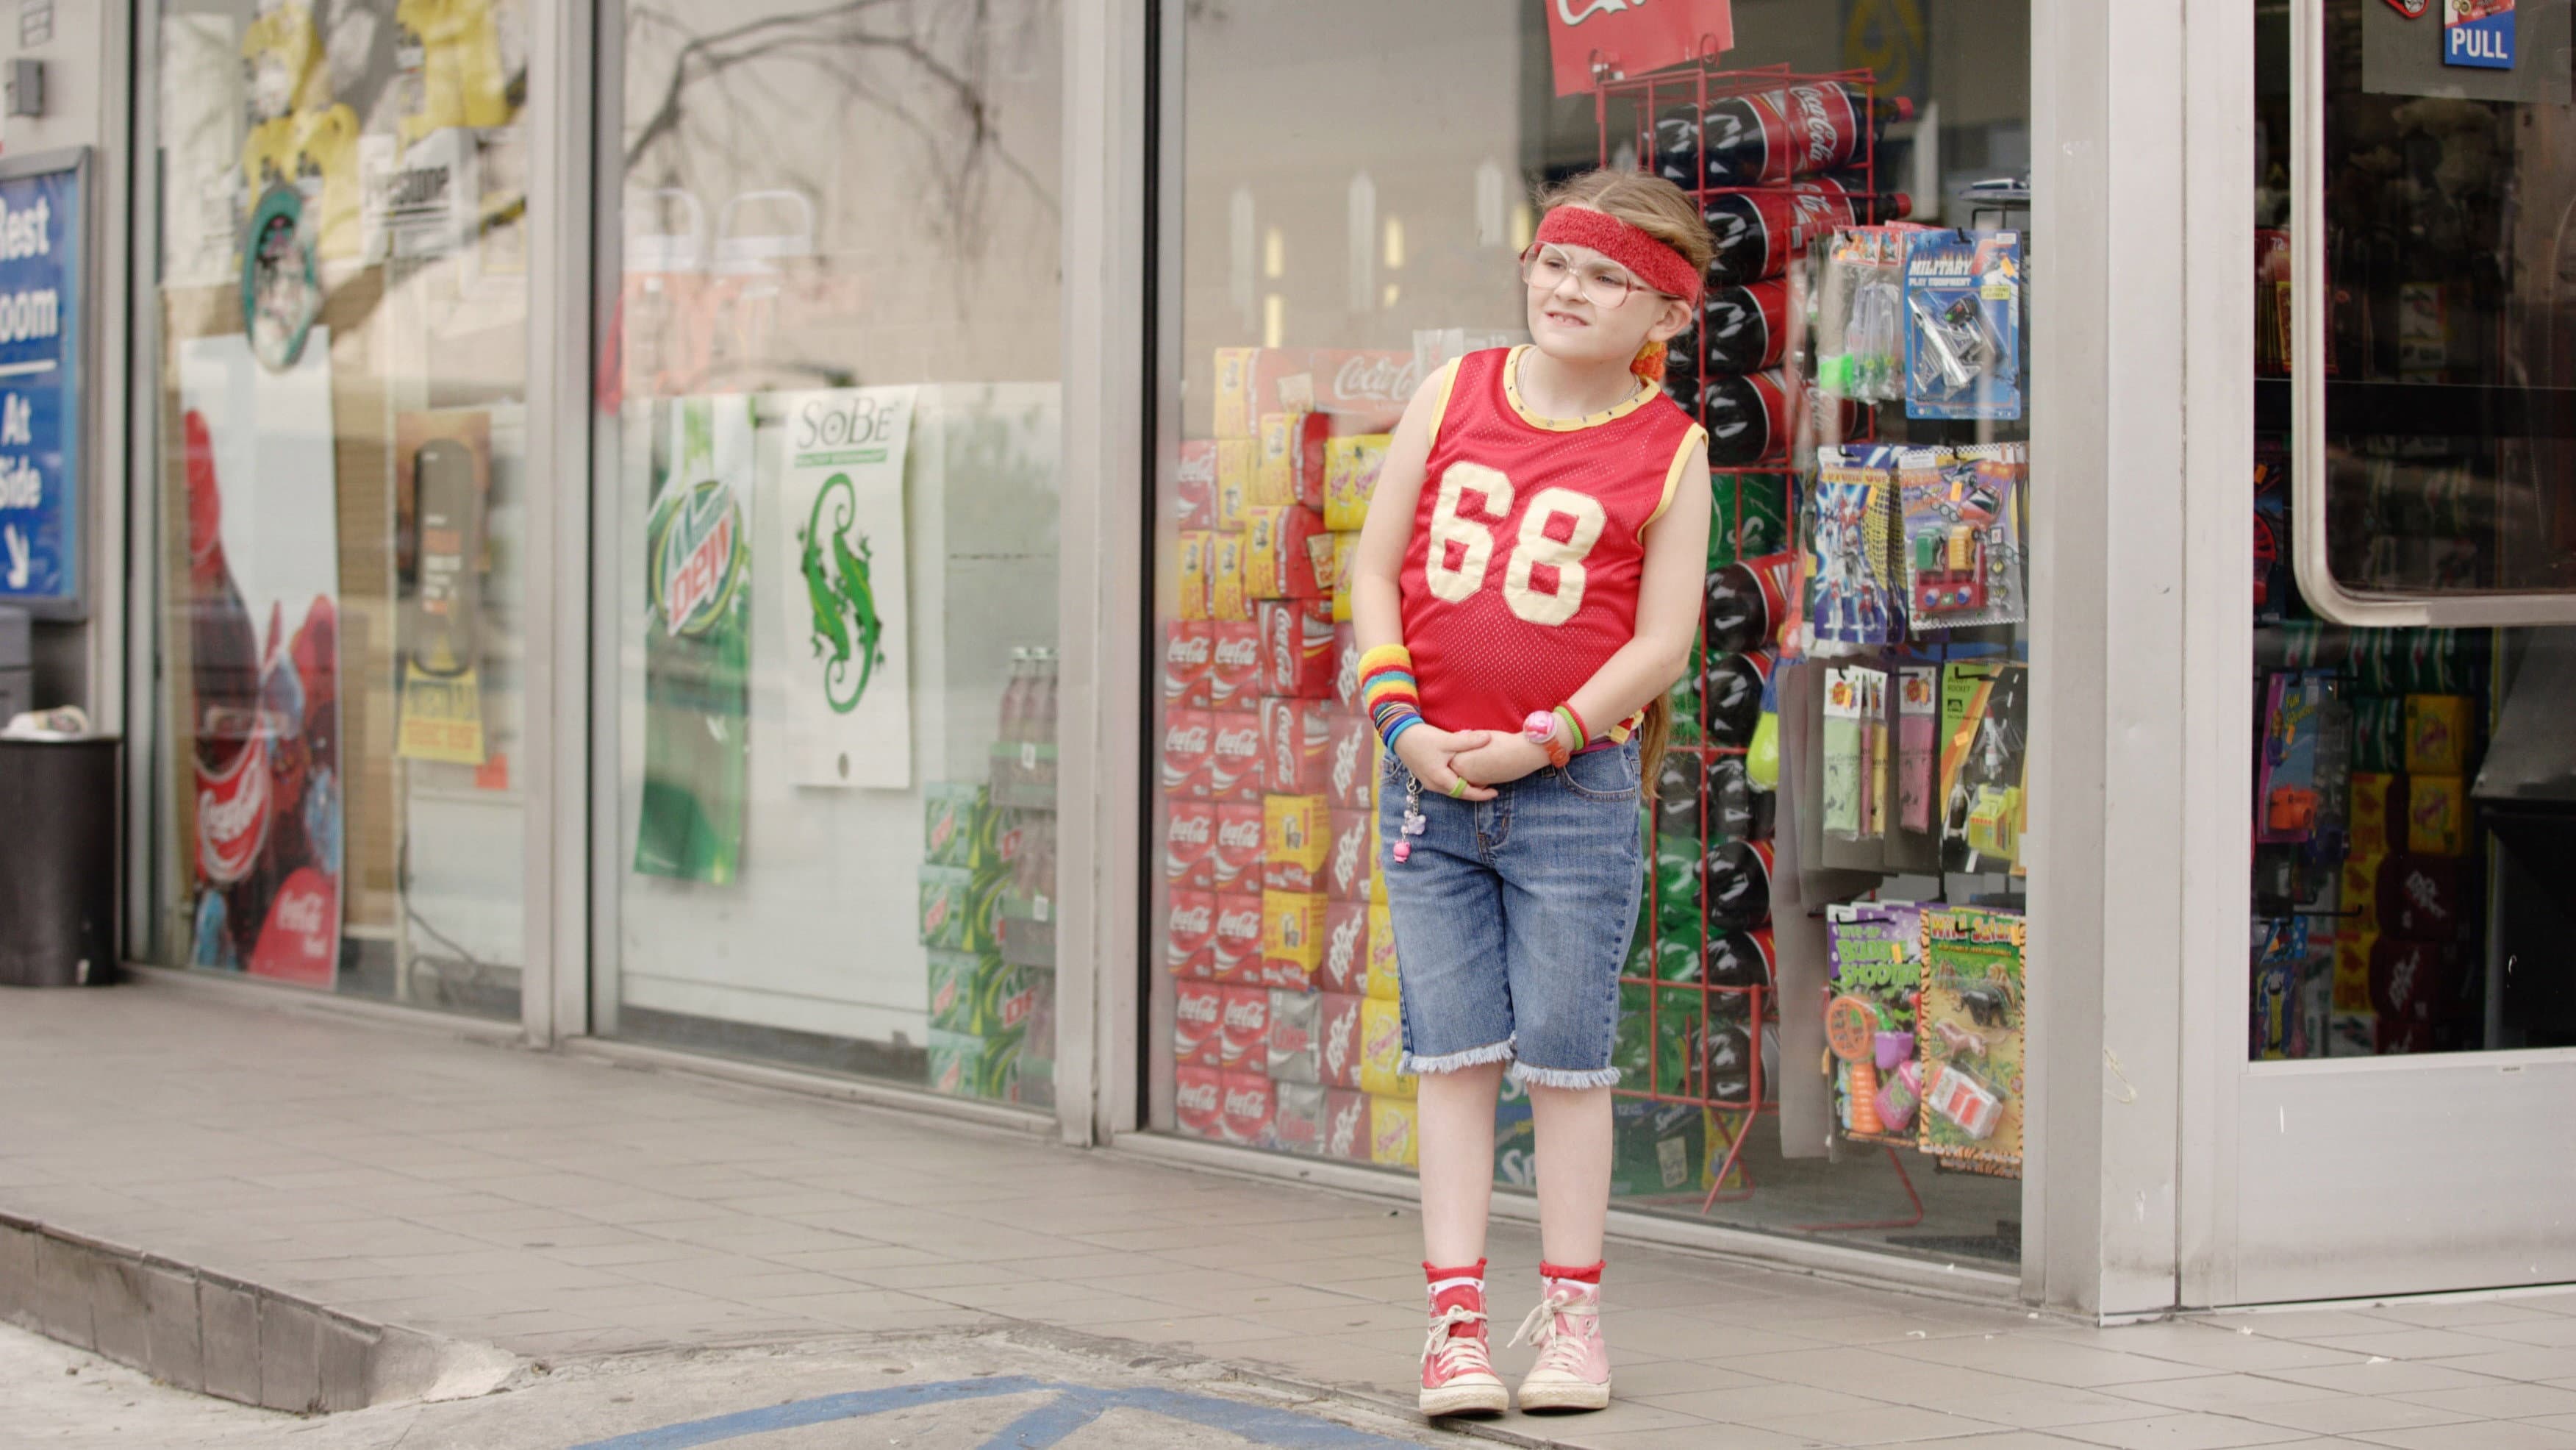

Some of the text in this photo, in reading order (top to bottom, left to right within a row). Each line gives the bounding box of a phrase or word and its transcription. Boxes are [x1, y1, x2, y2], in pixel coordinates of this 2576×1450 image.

[2452, 27, 2508, 59] PULL
[1908, 277, 1927, 287] PLAY
[1909, 258, 1974, 276] MILITARY
[2, 392, 32, 446] At
[1425, 460, 1608, 627] 68
[1971, 916, 2013, 944] Safar
